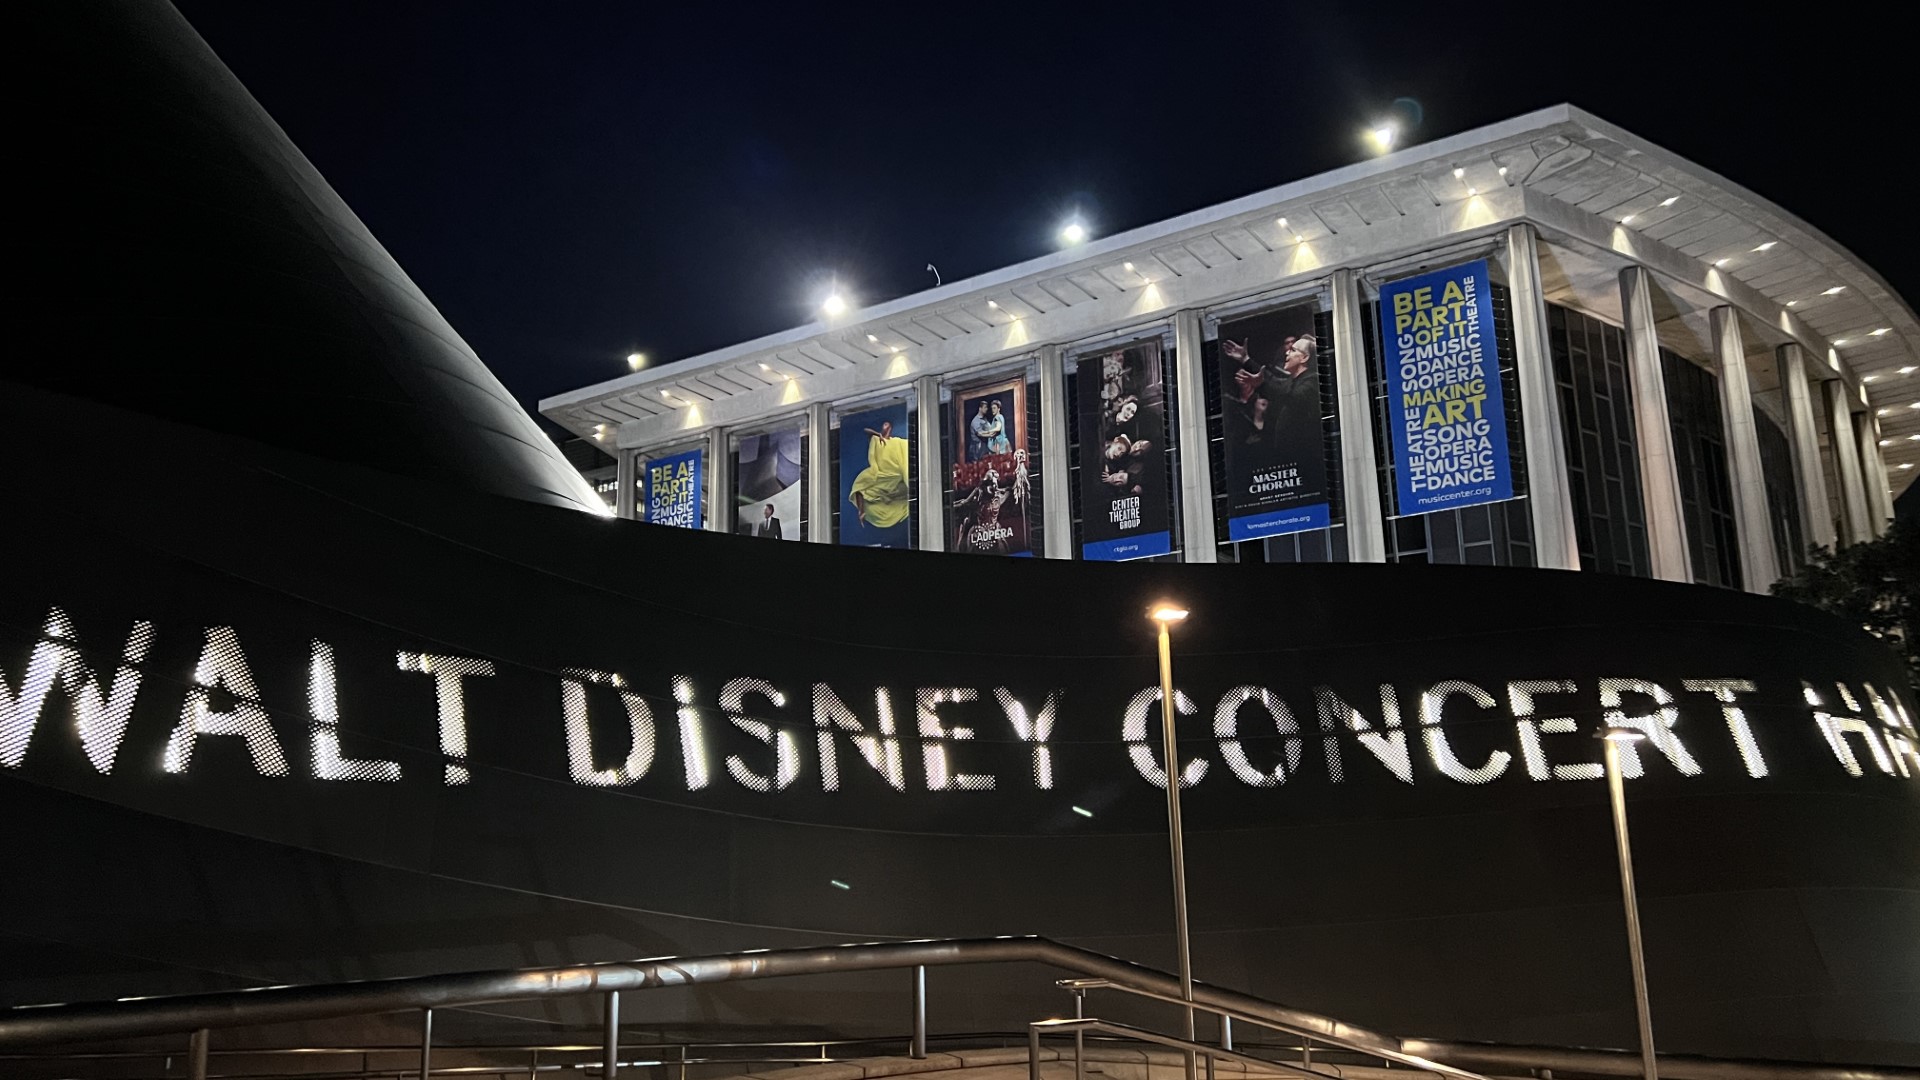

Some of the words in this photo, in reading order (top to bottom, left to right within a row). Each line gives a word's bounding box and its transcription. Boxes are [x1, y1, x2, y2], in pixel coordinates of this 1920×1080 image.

[1393, 286, 1432, 316] BE
[1441, 280, 1465, 305] A
[1463, 275, 1479, 334] THEATRE
[1396, 301, 1466, 334] PART
[1415, 325, 1444, 346] OF
[1449, 320, 1467, 337] IT
[1416, 333, 1480, 362] MUSIC
[1398, 334, 1418, 392] SONG
[1418, 350, 1483, 376] DANCE
[1419, 366, 1484, 390] OPERA
[1403, 378, 1486, 409] MAKING
[1422, 394, 1487, 430] ART
[1423, 418, 1490, 446] SONG
[1405, 407, 1426, 492] THEATRE
[1425, 436, 1492, 461] OPERA
[651, 464, 673, 483] BE
[676, 461, 688, 478] A
[1426, 450, 1493, 476] MUSIC
[652, 477, 688, 498] PART
[1248, 477, 1303, 494] CHORALE
[1253, 468, 1298, 484] MASTER
[1427, 466, 1495, 491] DANCE
[661, 494, 677, 507] OF
[679, 491, 688, 503] IT
[1112, 496, 1140, 511] CENTER
[1418, 486, 1492, 505] musiccenter.org
[661, 501, 693, 517] MUSIC
[1109, 507, 1140, 523] THEATRE
[1119, 518, 1140, 530] GROUP
[0, 605, 496, 786] WALT
[561, 667, 1065, 793] DISNEY
[1122, 677, 1769, 789] CONCERT
